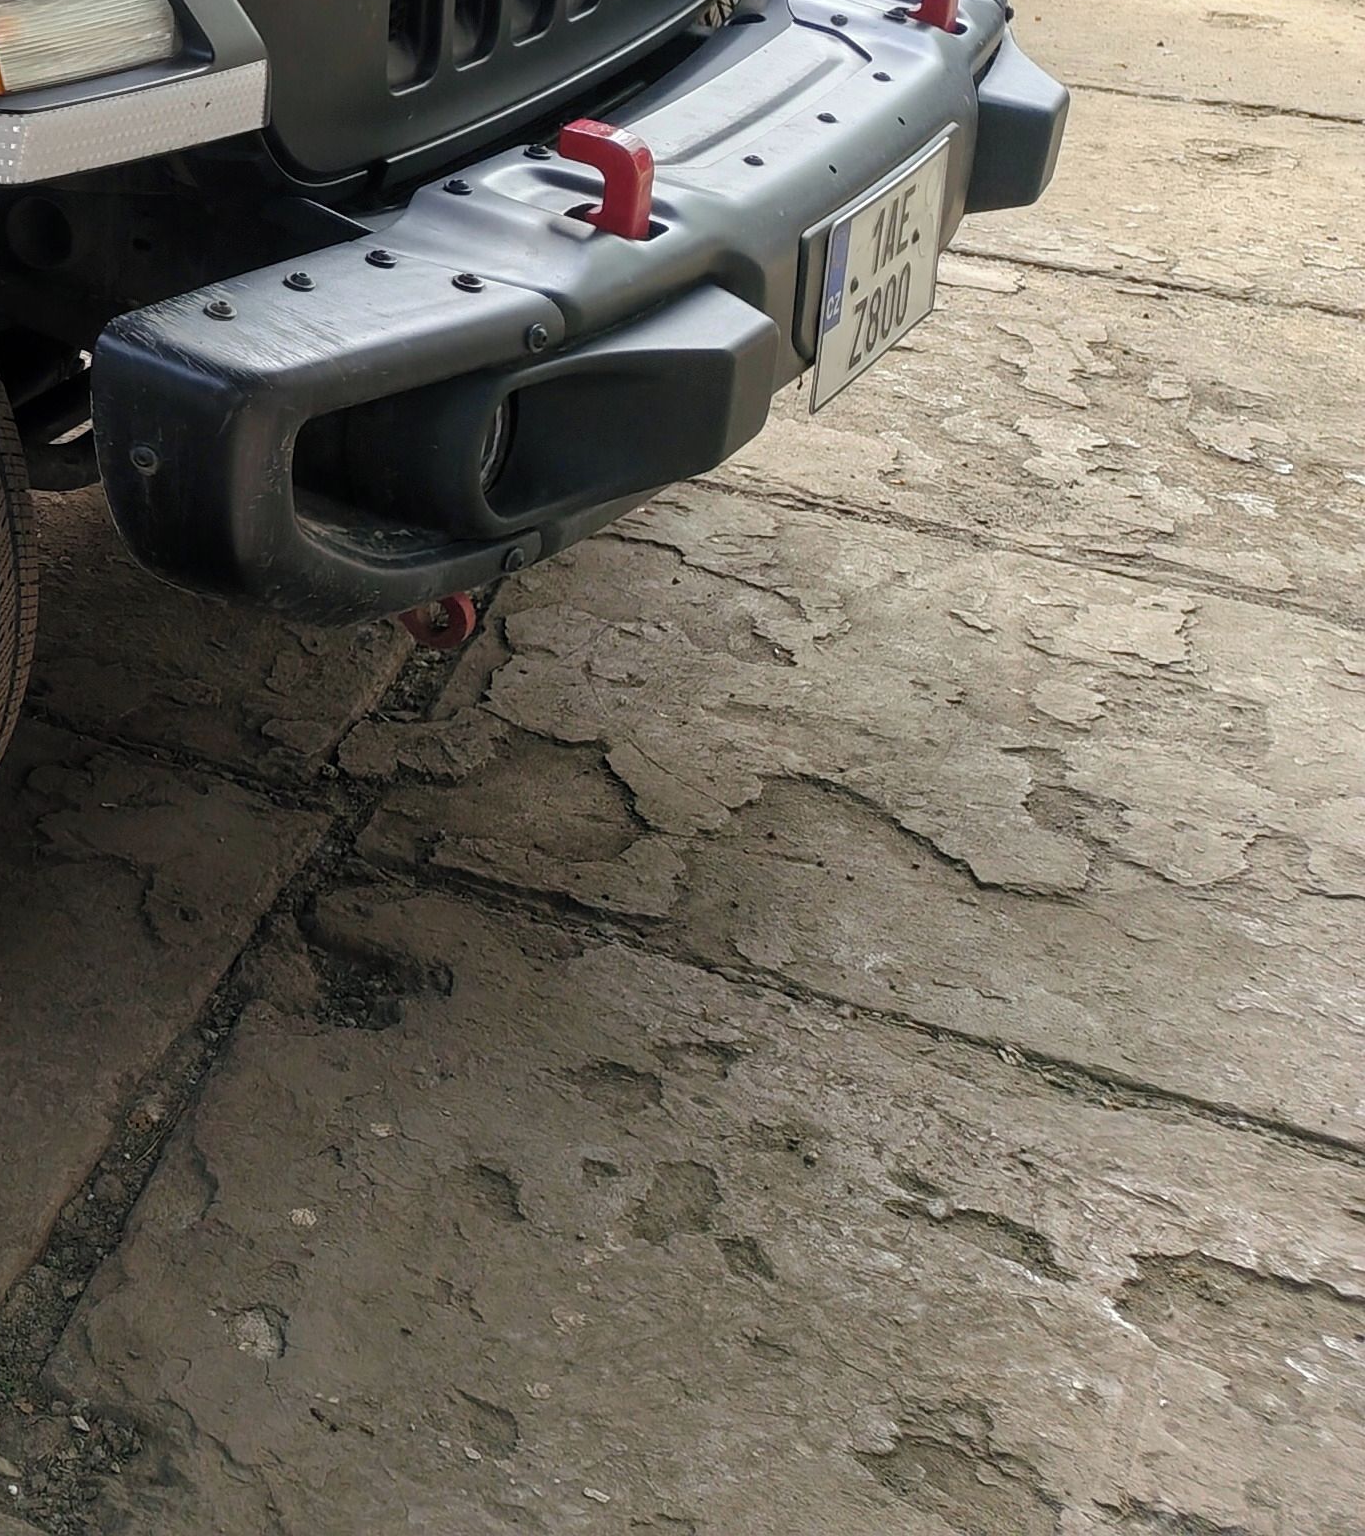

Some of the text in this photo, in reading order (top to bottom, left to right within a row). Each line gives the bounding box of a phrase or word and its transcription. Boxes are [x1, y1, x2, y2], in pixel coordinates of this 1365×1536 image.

[872, 183, 917, 276] 1AE
[825, 290, 842, 321] CZ
[848, 261, 912, 371] Z800
